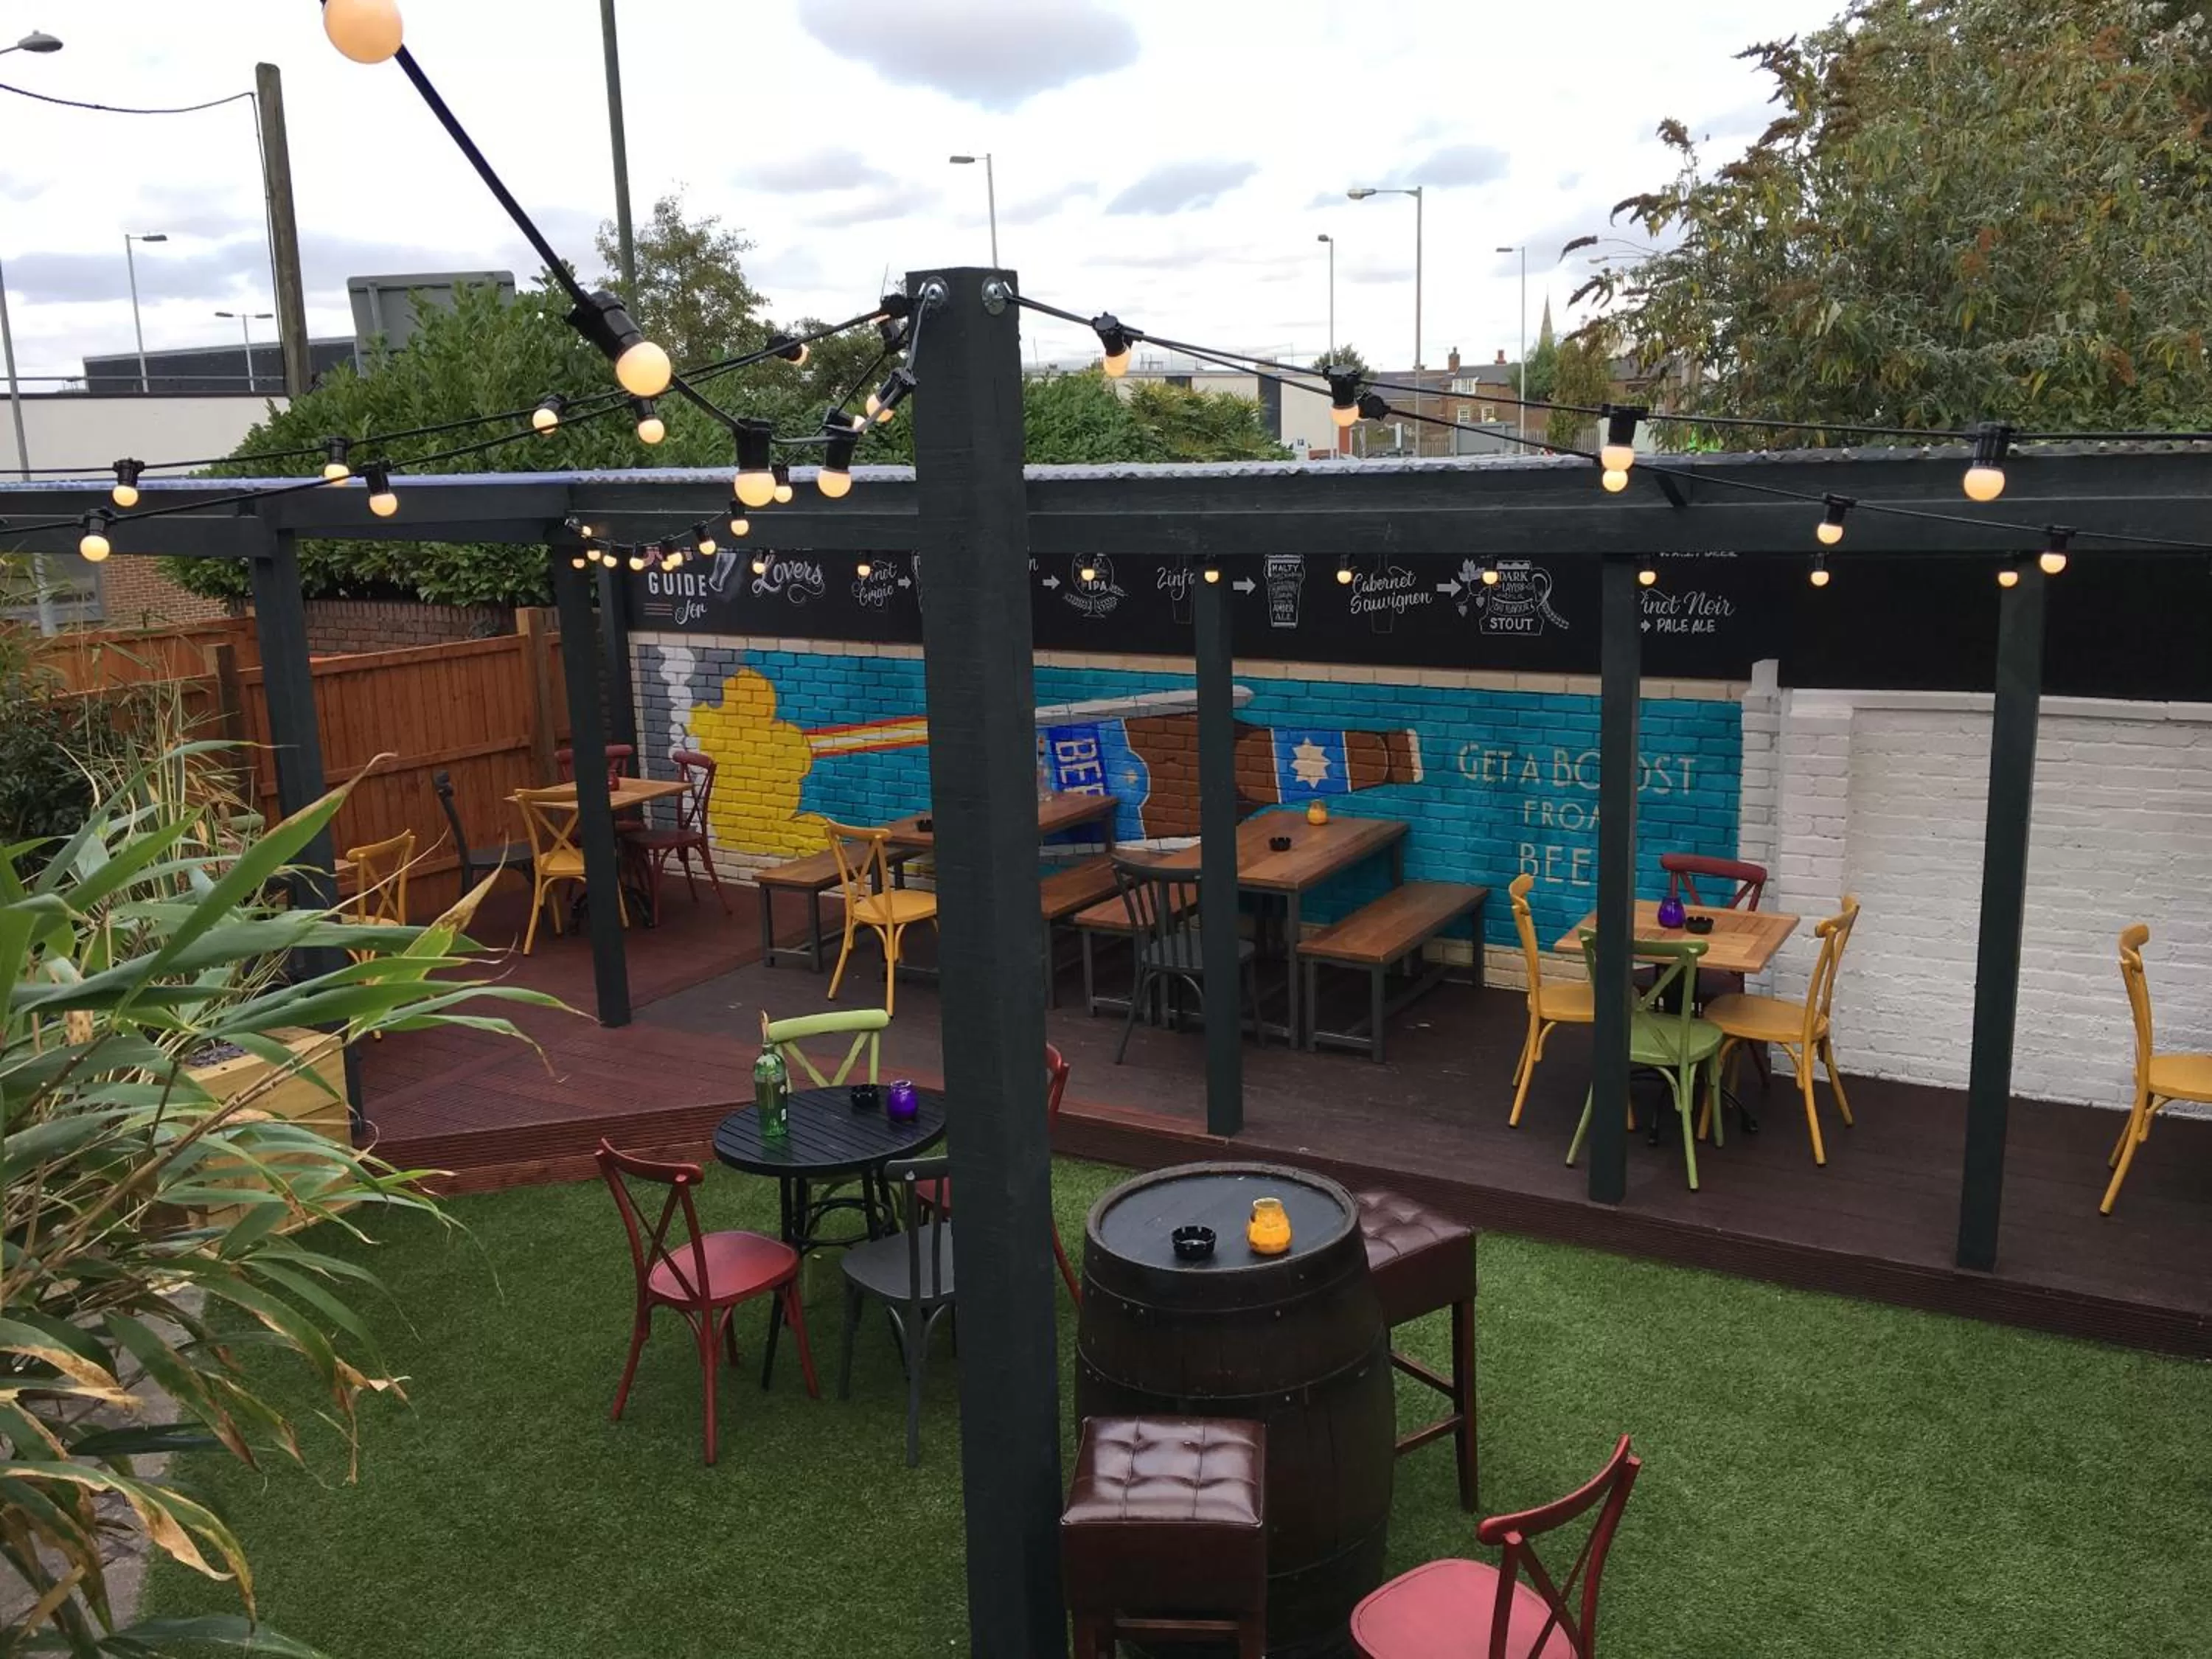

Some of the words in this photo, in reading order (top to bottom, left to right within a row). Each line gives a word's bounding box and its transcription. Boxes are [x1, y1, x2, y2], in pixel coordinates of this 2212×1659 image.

[648, 571, 708, 597] GUIDE
[751, 552, 826, 605] Lovers
[1352, 566, 1416, 595] Cabernet
[1499, 571, 1528, 582] DARK
[675, 599, 708, 625] for
[1350, 591, 1433, 614] Sauvignon
[1641, 588, 1682, 615] inot
[1683, 591, 1737, 616] Noir
[1489, 617, 1534, 630] STOUT
[1656, 618, 1689, 633] PALE
[1691, 619, 1716, 634] ALE
[1459, 743, 1513, 783] GET
[1520, 752, 1542, 785] A
[1519, 843, 1593, 886] BEE
